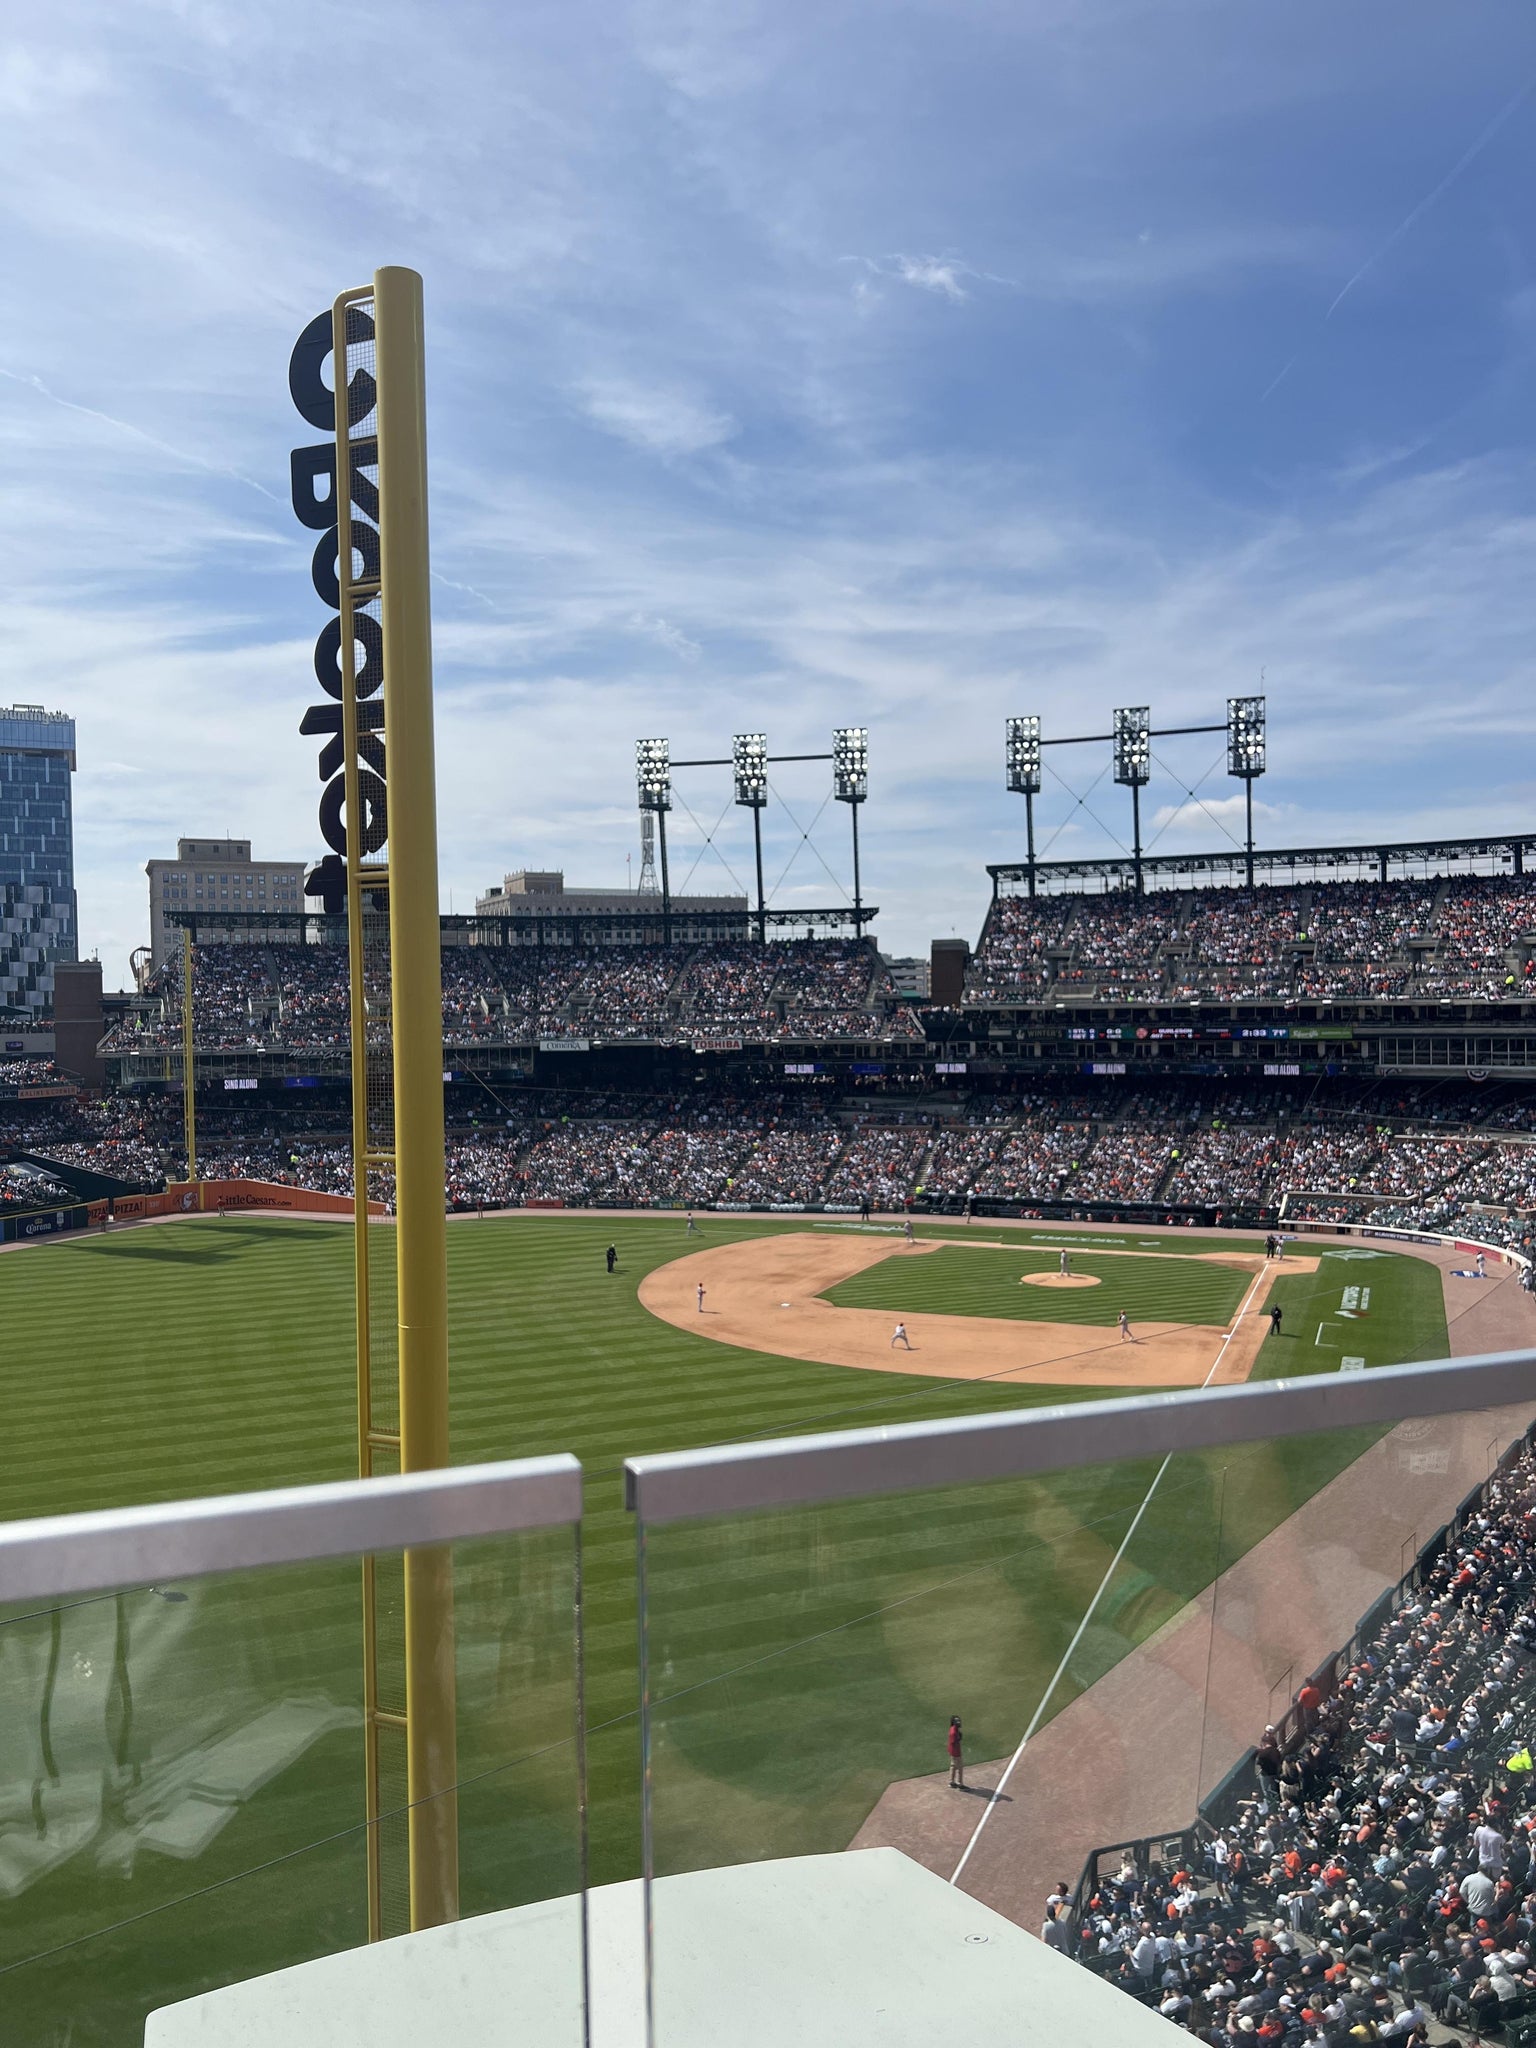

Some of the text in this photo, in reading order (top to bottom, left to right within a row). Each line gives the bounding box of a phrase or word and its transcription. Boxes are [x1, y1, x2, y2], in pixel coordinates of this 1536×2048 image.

[0, 707, 70, 725] Huntington
[693, 1041, 741, 1049] TOSHIBA
[1263, 1064, 1300, 1076] SING ALONG
[224, 1079, 239, 1090] SING
[246, 1194, 292, 1206] Caesars.com
[115, 1202, 143, 1214] PIZZA!
[25, 1223, 52, 1235] Corona
